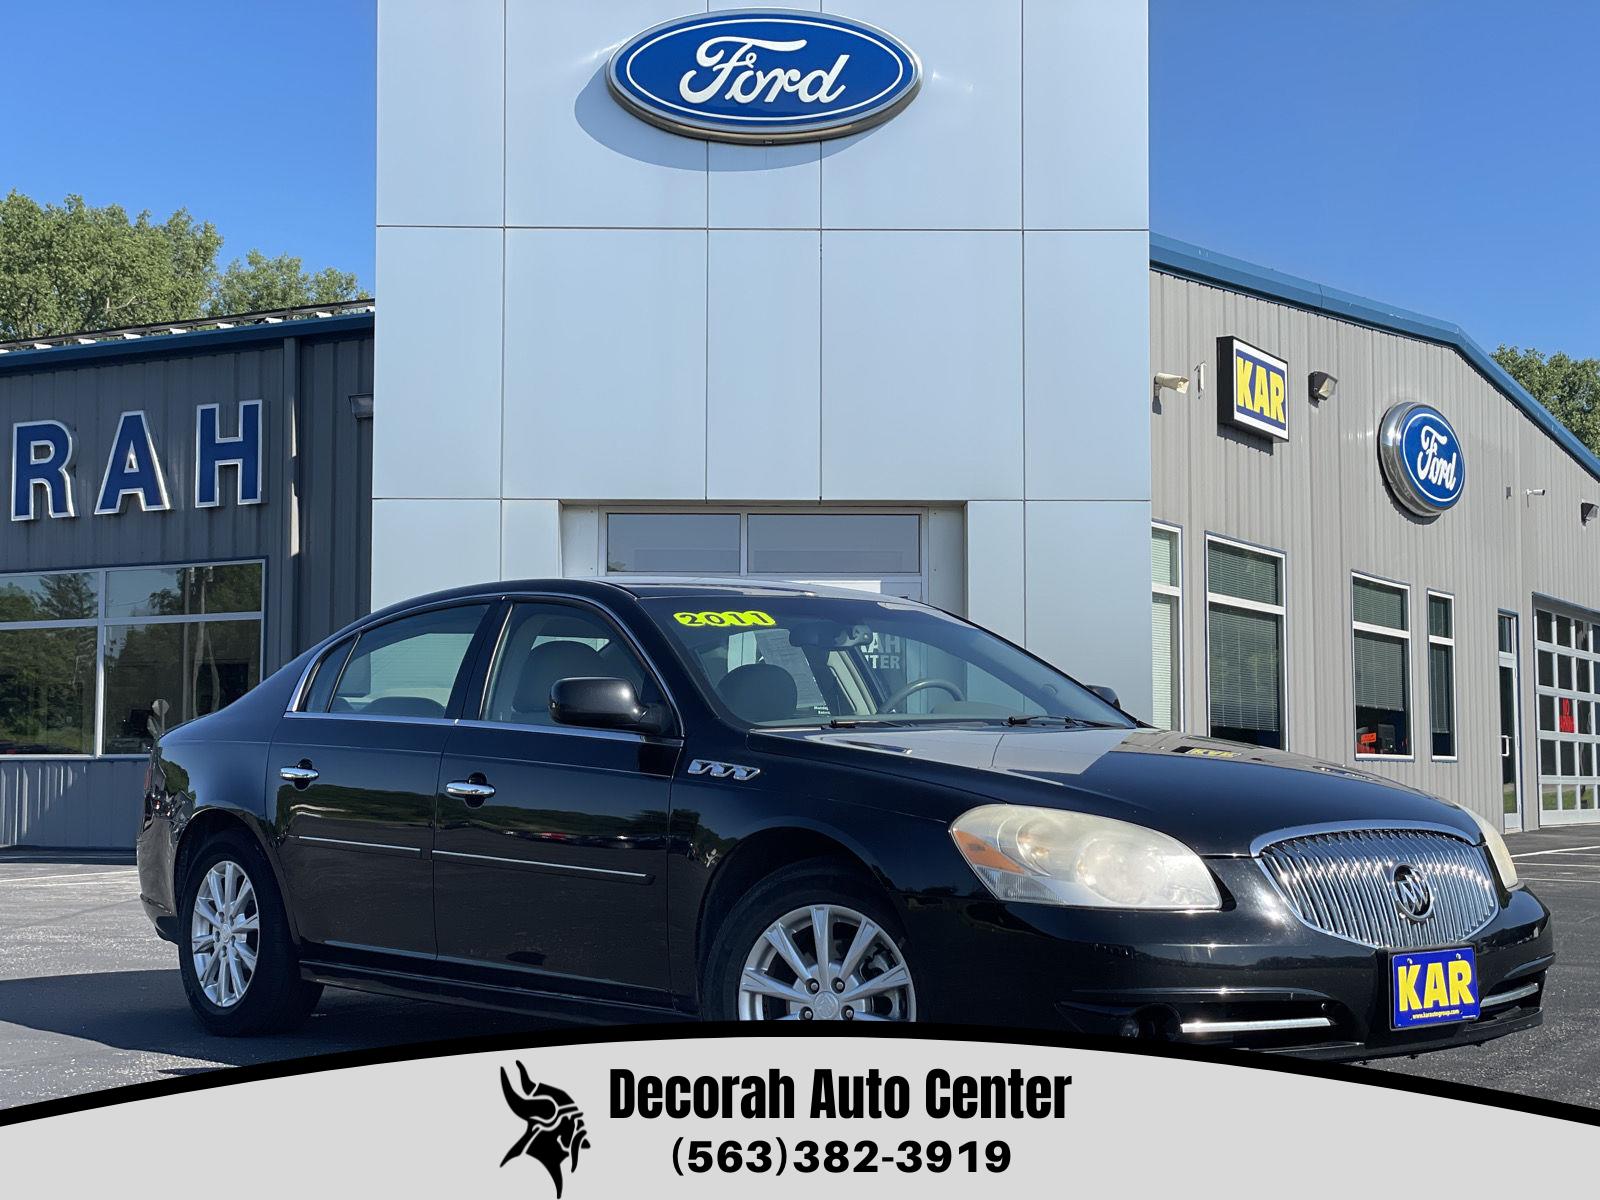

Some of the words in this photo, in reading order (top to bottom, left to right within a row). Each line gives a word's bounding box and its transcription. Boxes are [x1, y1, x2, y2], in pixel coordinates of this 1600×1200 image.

[679, 36, 850, 104] Ford
[1236, 356, 1286, 424] KAR
[1416, 425, 1457, 491] Ford
[678, 612, 769, 625] 2011
[1397, 960, 1475, 1012] KAR
